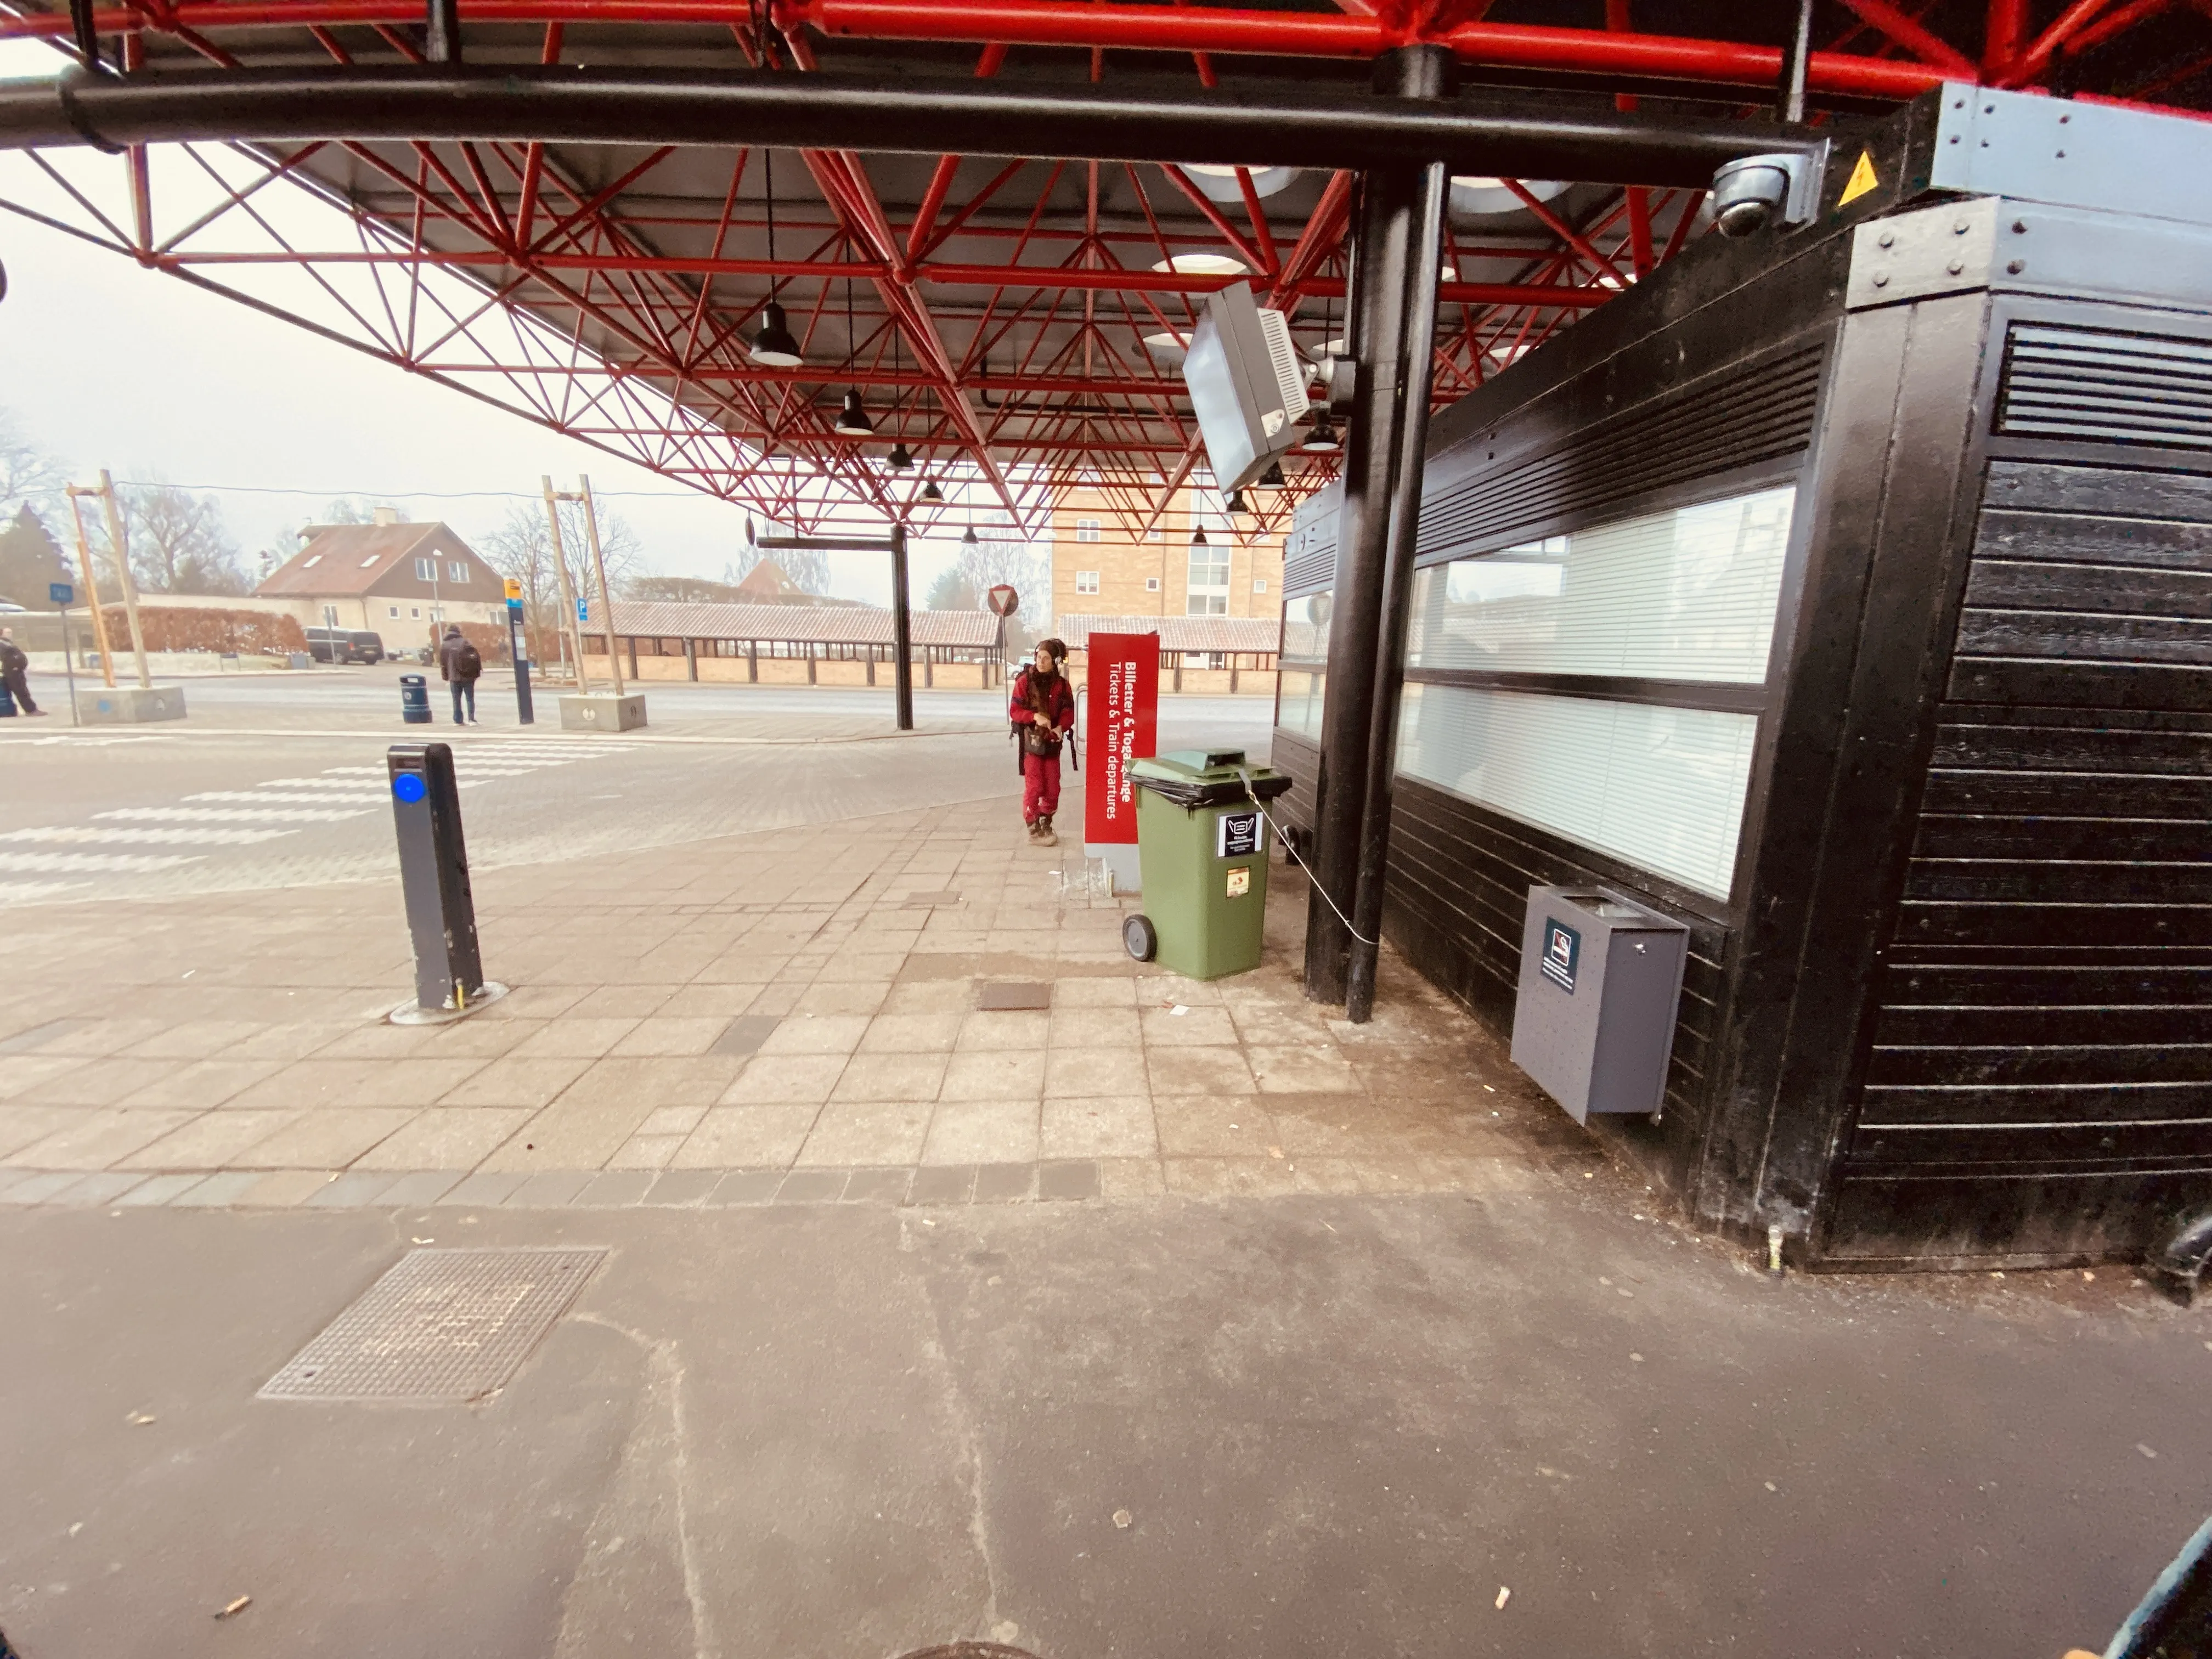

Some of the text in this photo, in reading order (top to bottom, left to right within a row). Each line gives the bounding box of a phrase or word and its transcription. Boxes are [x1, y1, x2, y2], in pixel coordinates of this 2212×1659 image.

[1105, 661, 1121, 819] Tickets & Train departures
[1120, 662, 1136, 803] Billetter & Togagnge
